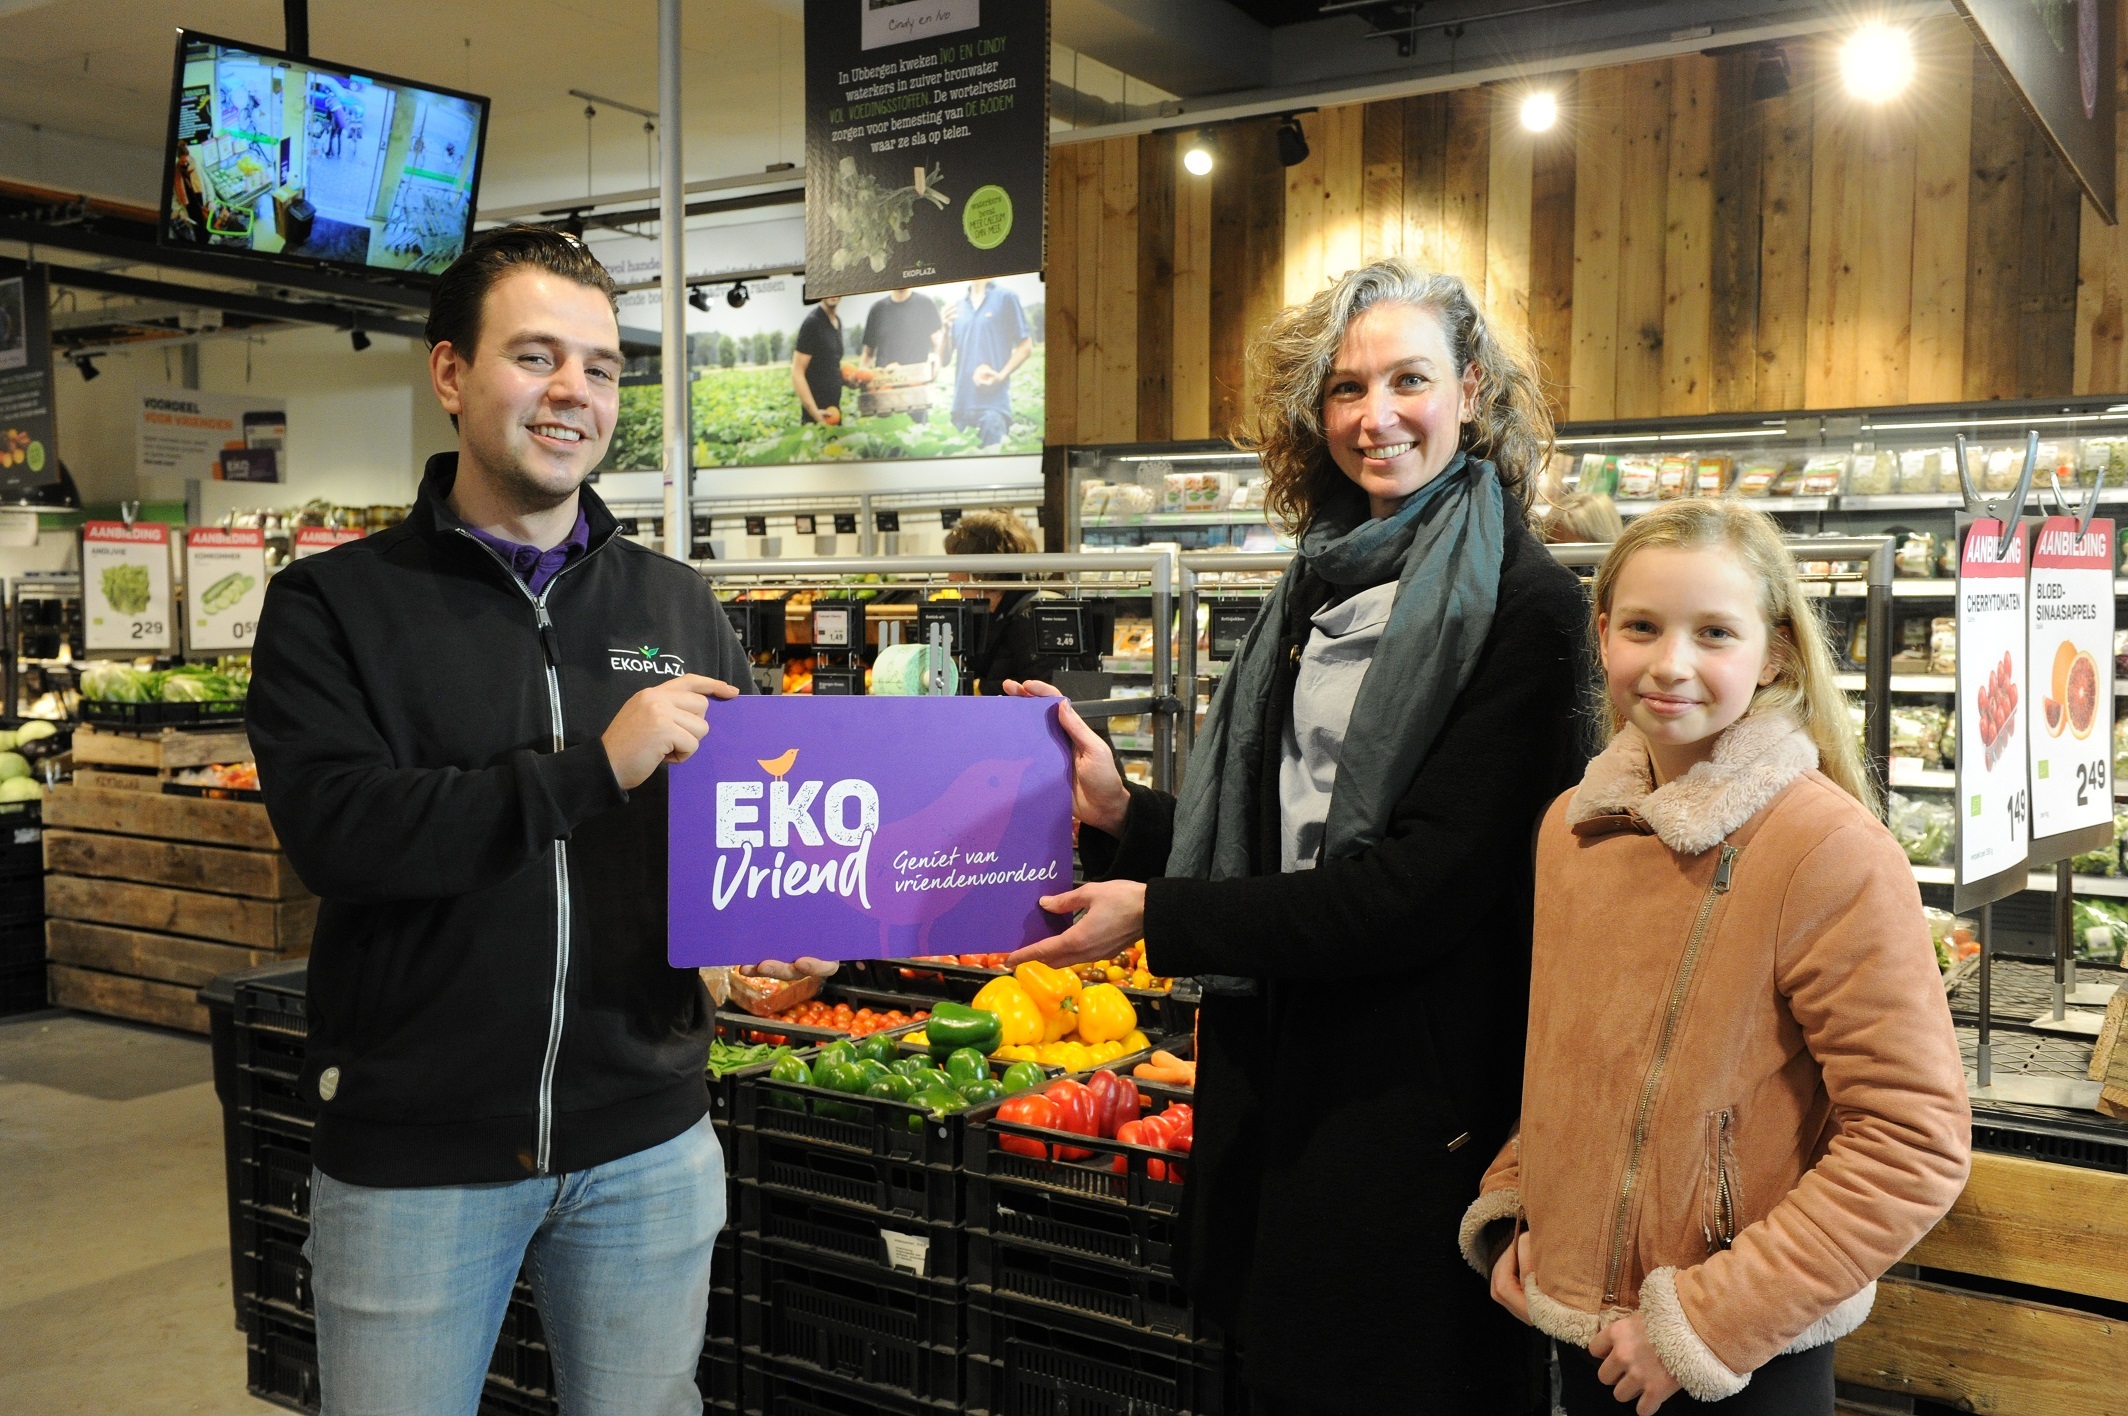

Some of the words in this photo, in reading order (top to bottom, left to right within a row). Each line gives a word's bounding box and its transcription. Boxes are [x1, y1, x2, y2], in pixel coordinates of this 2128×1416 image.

[888, 17, 915, 35] Cindy
[918, 15, 932, 25] en
[936, 10, 952, 24] Ivo
[838, 72, 850, 85] In
[851, 64, 898, 83] Ubbergen
[899, 53, 938, 73] kweken
[960, 44, 973, 60] EN
[978, 36, 1007, 56] CINDY
[846, 81, 895, 102] waterkers
[897, 78, 908, 92] in
[910, 71, 942, 90] zuiver
[944, 60, 999, 82] bronwater
[830, 108, 844, 124] VOL
[934, 89, 948, 104] De
[950, 76, 1016, 100] wortelresten
[832, 126, 865, 142] zorgen
[867, 122, 888, 135] voor
[890, 109, 943, 131] bemesting
[944, 108, 964, 121] van
[966, 101, 978, 117] DE
[980, 94, 1014, 114] BODEM
[871, 139, 896, 153] waar
[898, 136, 910, 148] ze
[912, 131, 926, 146] sla
[929, 130, 941, 144] op
[942, 123, 972, 141] telen.
[902, 268, 936, 278] EKOPLAZA
[2038, 530, 2106, 558] AANBIEDING
[1967, 593, 2021, 612] CHERRYTOMATEN
[2037, 583, 2066, 599] BLOED-
[2036, 604, 2097, 620] SINAASAPPELS
[1056, 637, 1074, 646] 2,49
[715, 778, 880, 848] EKO
[712, 829, 872, 911] Vriend
[893, 846, 959, 875] Geniet
[965, 851, 999, 865] van
[894, 860, 1058, 893] vriendenvoordeel
